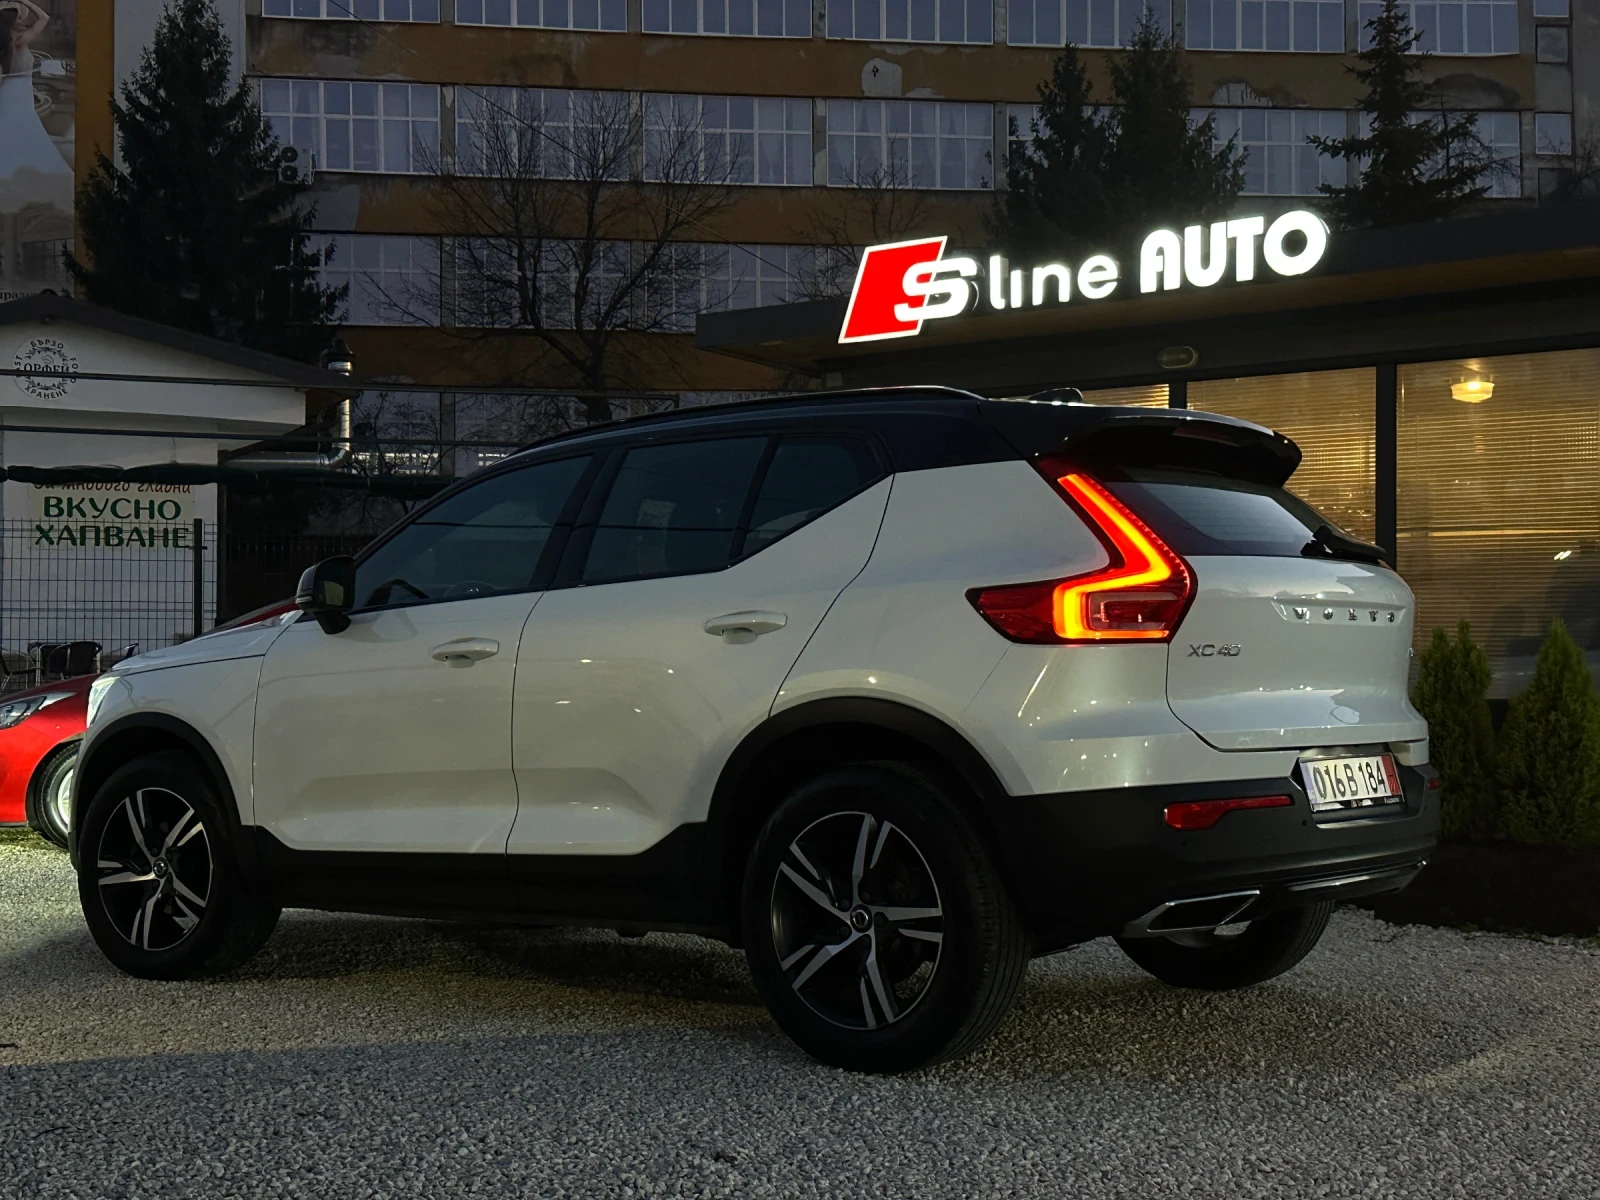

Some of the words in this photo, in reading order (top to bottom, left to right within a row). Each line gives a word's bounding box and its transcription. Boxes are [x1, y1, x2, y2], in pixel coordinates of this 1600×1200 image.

[893, 256, 978, 321] S
[989, 254, 1120, 310] line
[1139, 209, 1330, 294] AUTO
[30, 338, 64, 349] БЪРЗО
[69, 357, 80, 384] FOD
[25, 385, 69, 400] ХРАНЕНЕ
[43, 496, 182, 520] ВКУСНО
[35, 524, 191, 549] ХАПВАНЕ
[1186, 643, 1242, 657] XC40
